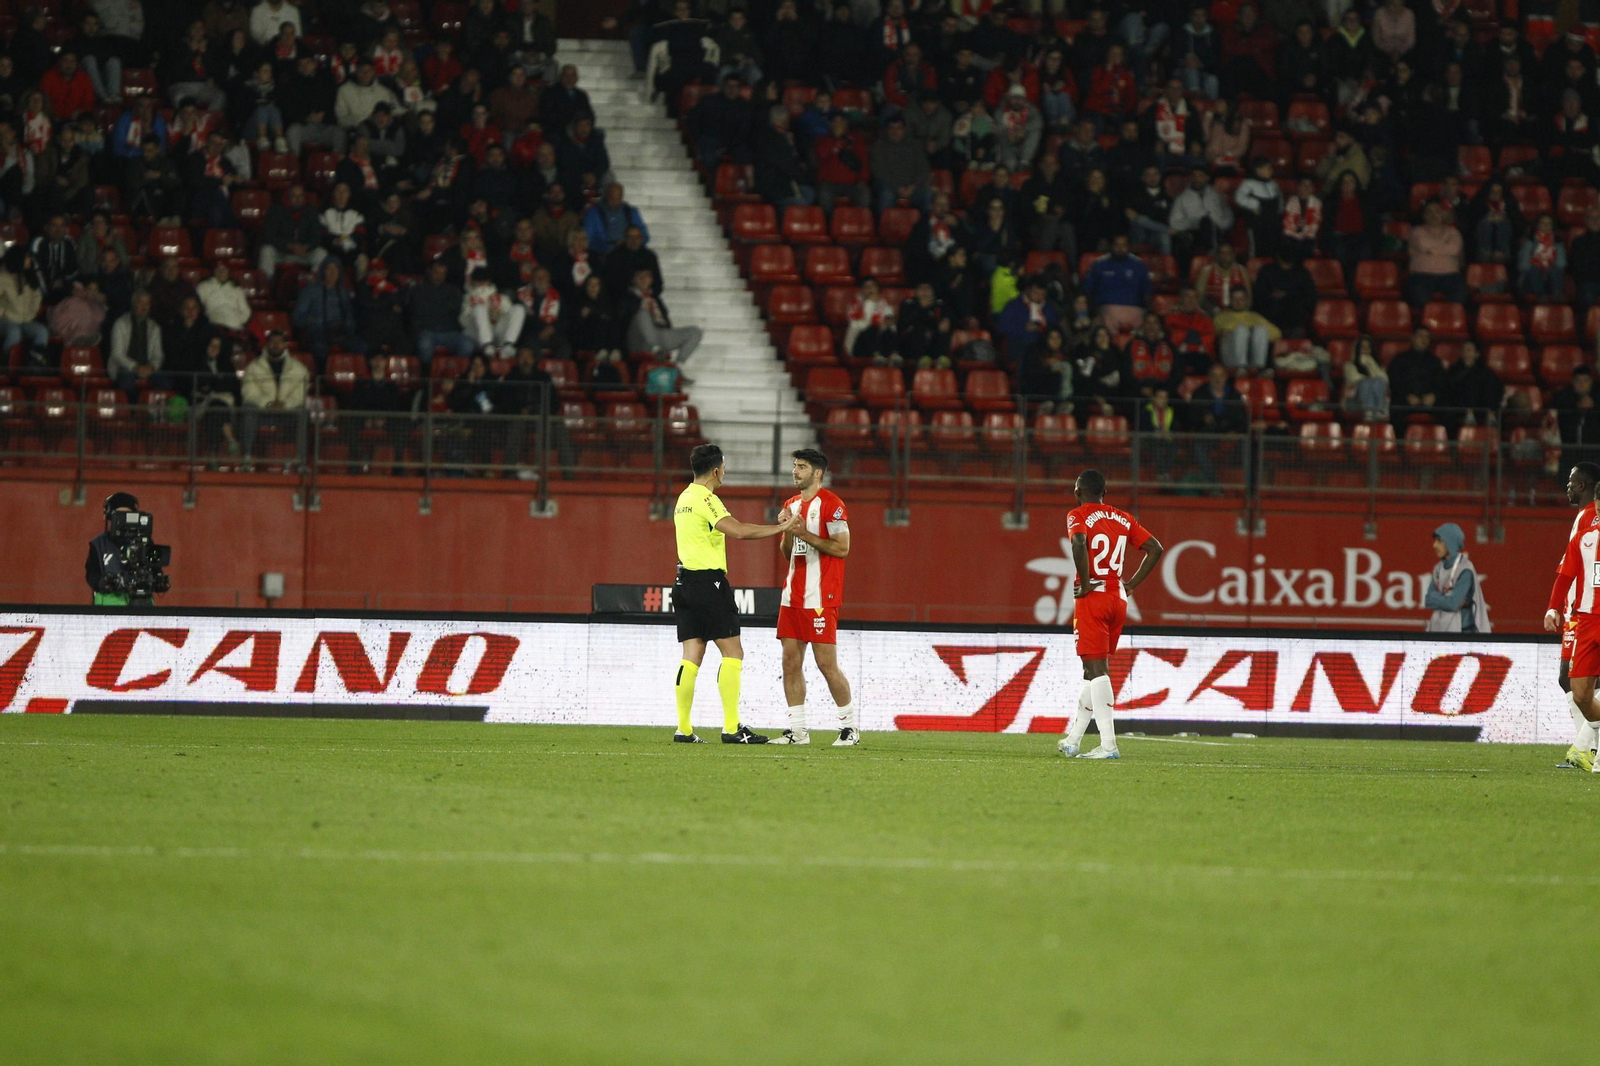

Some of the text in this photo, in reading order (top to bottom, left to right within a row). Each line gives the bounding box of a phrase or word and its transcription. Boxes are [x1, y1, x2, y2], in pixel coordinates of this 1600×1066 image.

[1091, 533, 1127, 577] 24
[1105, 511, 1131, 531] LANGA
[1161, 539, 1492, 610] CaixaBa
[86, 628, 520, 696] CANO
[1109, 648, 1512, 716] CANO
